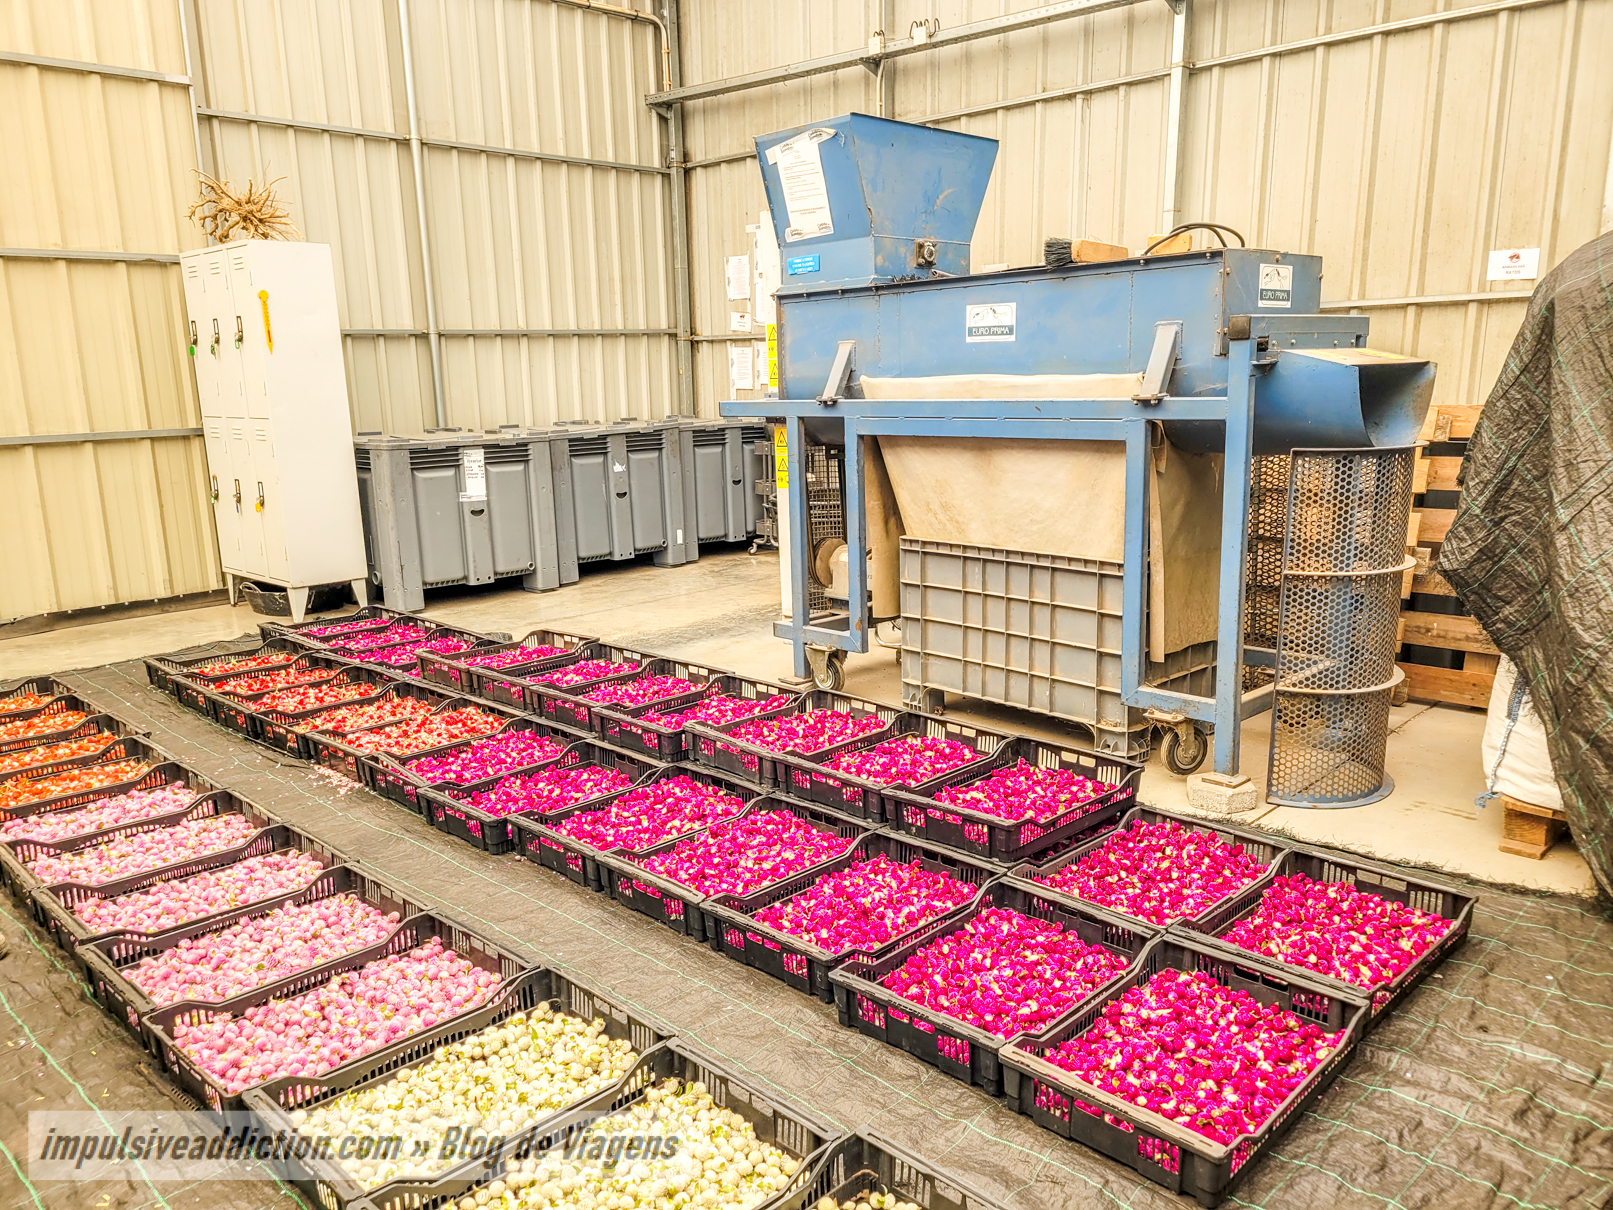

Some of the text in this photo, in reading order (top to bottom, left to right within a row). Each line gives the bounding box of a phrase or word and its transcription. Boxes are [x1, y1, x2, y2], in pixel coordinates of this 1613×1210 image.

[1263, 290, 1288, 300] EURO PRIMA
[972, 326, 1010, 336] EURO PRIMA
